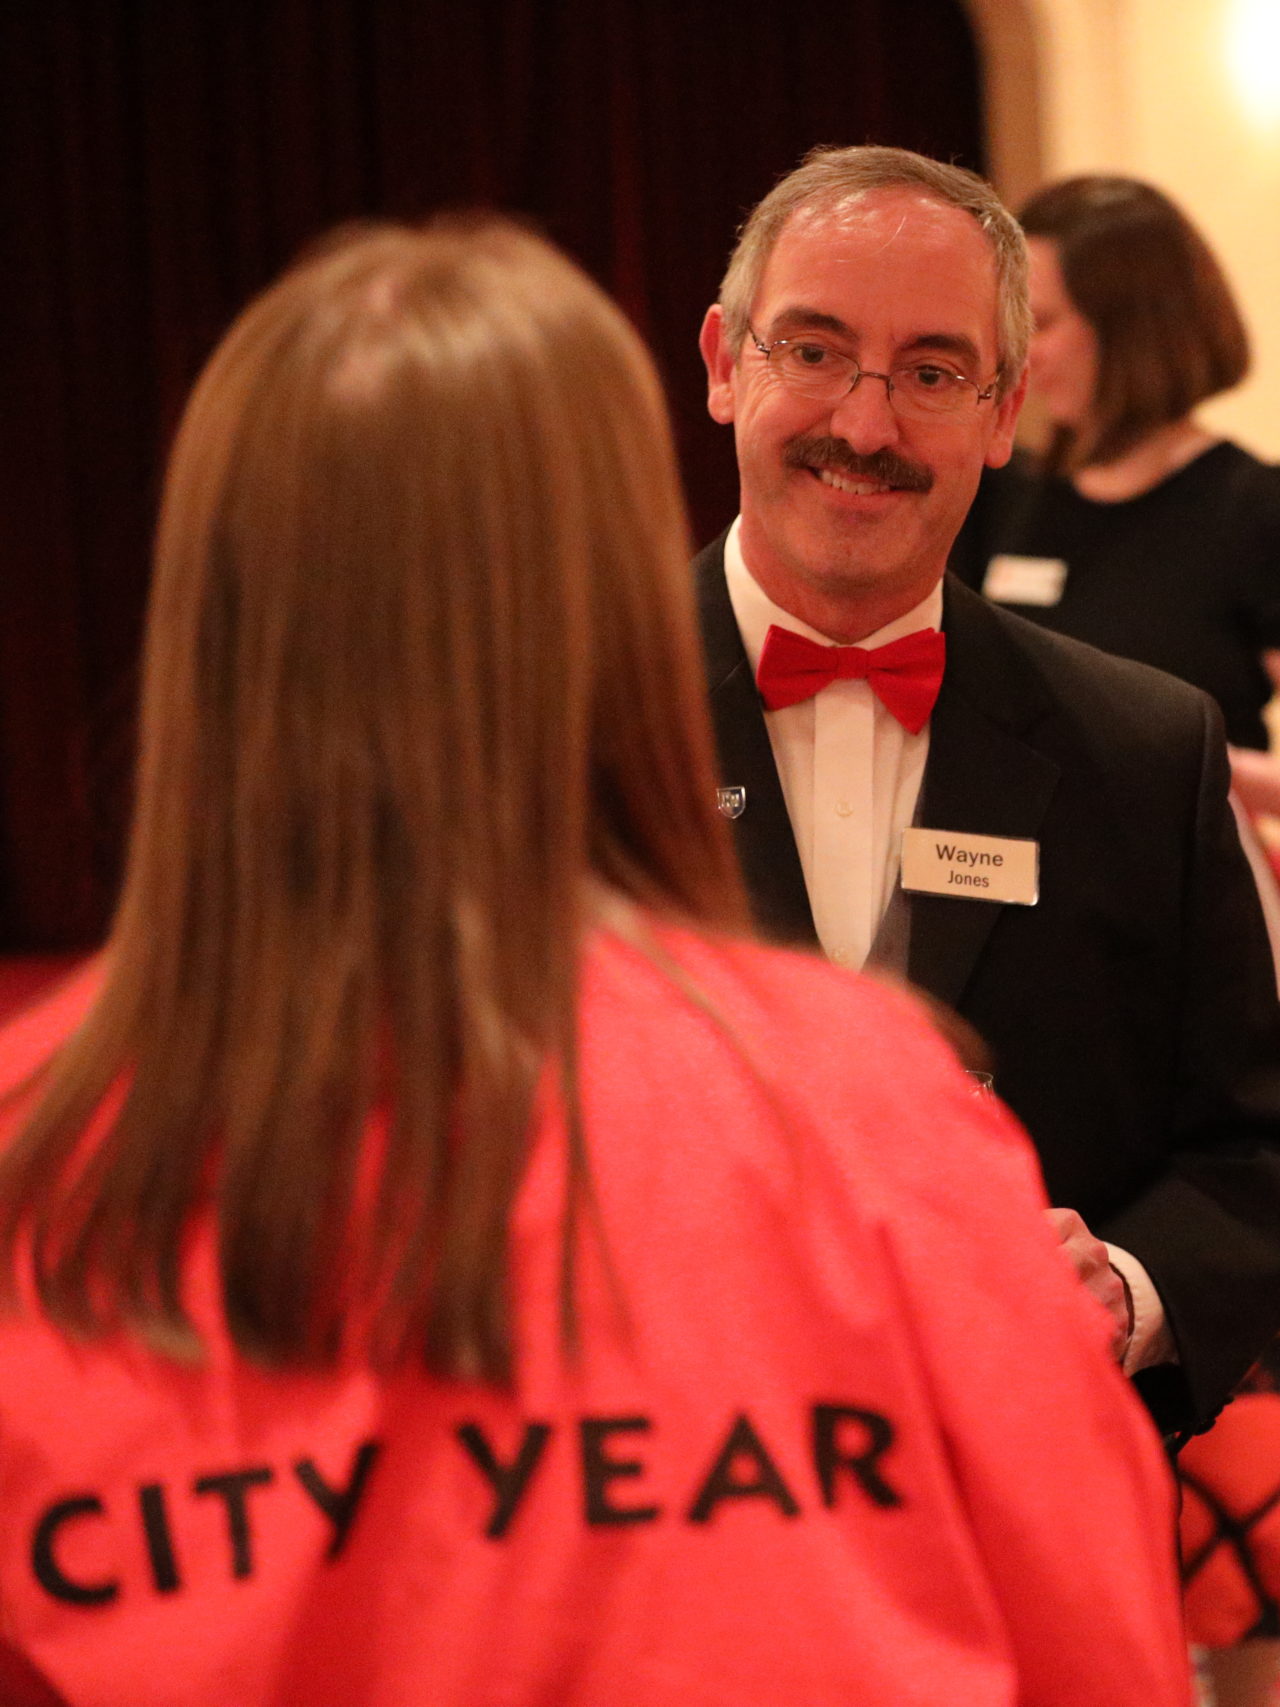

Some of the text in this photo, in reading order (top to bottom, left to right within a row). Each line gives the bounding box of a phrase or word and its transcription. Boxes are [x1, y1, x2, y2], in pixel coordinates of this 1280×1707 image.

[935, 843, 1004, 868] Wayne
[947, 869, 990, 889] Jones
[29, 1402, 904, 1608] CITY YEAR
